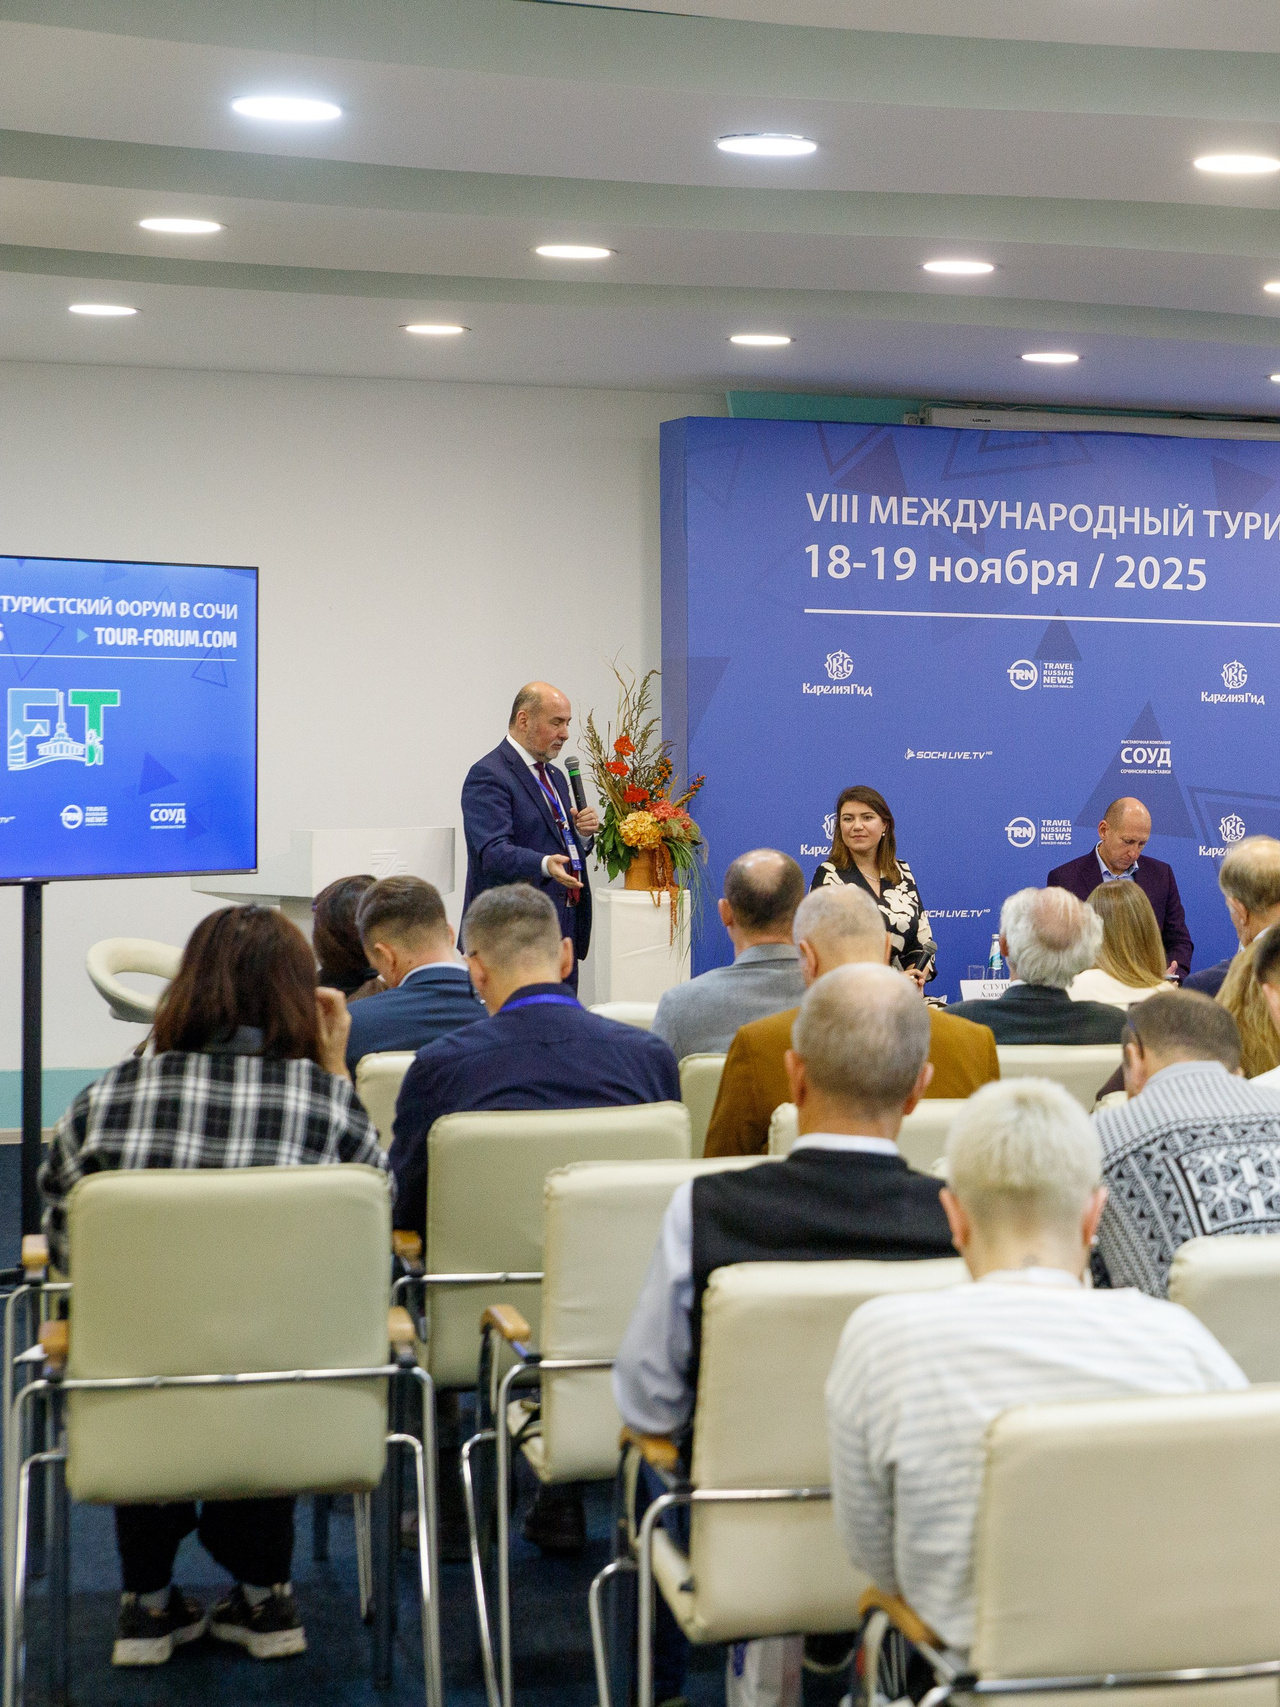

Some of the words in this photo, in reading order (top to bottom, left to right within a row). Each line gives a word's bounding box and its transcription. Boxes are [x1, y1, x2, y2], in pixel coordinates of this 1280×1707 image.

[805, 492, 859, 524] VIII
[869, 495, 1194, 540] МЕЖДУНАРОДНЫЙ
[804, 544, 917, 581] 18-19
[929, 548, 1078, 595] ноября
[1088, 552, 1105, 589] /
[1114, 554, 1207, 592] 2025
[0, 595, 113, 616] ТУРИСТСКИЙ
[115, 599, 177, 618] ФОРУМ
[179, 601, 190, 618] В
[193, 602, 238, 620] СОЧИ
[94, 626, 238, 648] TOUR-FORUM.COM
[1043, 662, 1074, 670] TRAVEL
[1043, 676, 1074, 684] NEWS
[802, 682, 873, 697] КарелияГид
[1201, 691, 1265, 706] КарелияГид
[8, 688, 121, 771] FT
[915, 751, 947, 759] SOCHI
[1120, 747, 1172, 768] СОУД
[150, 808, 187, 824] СОУД
[1041, 833, 1072, 841] NEWS
